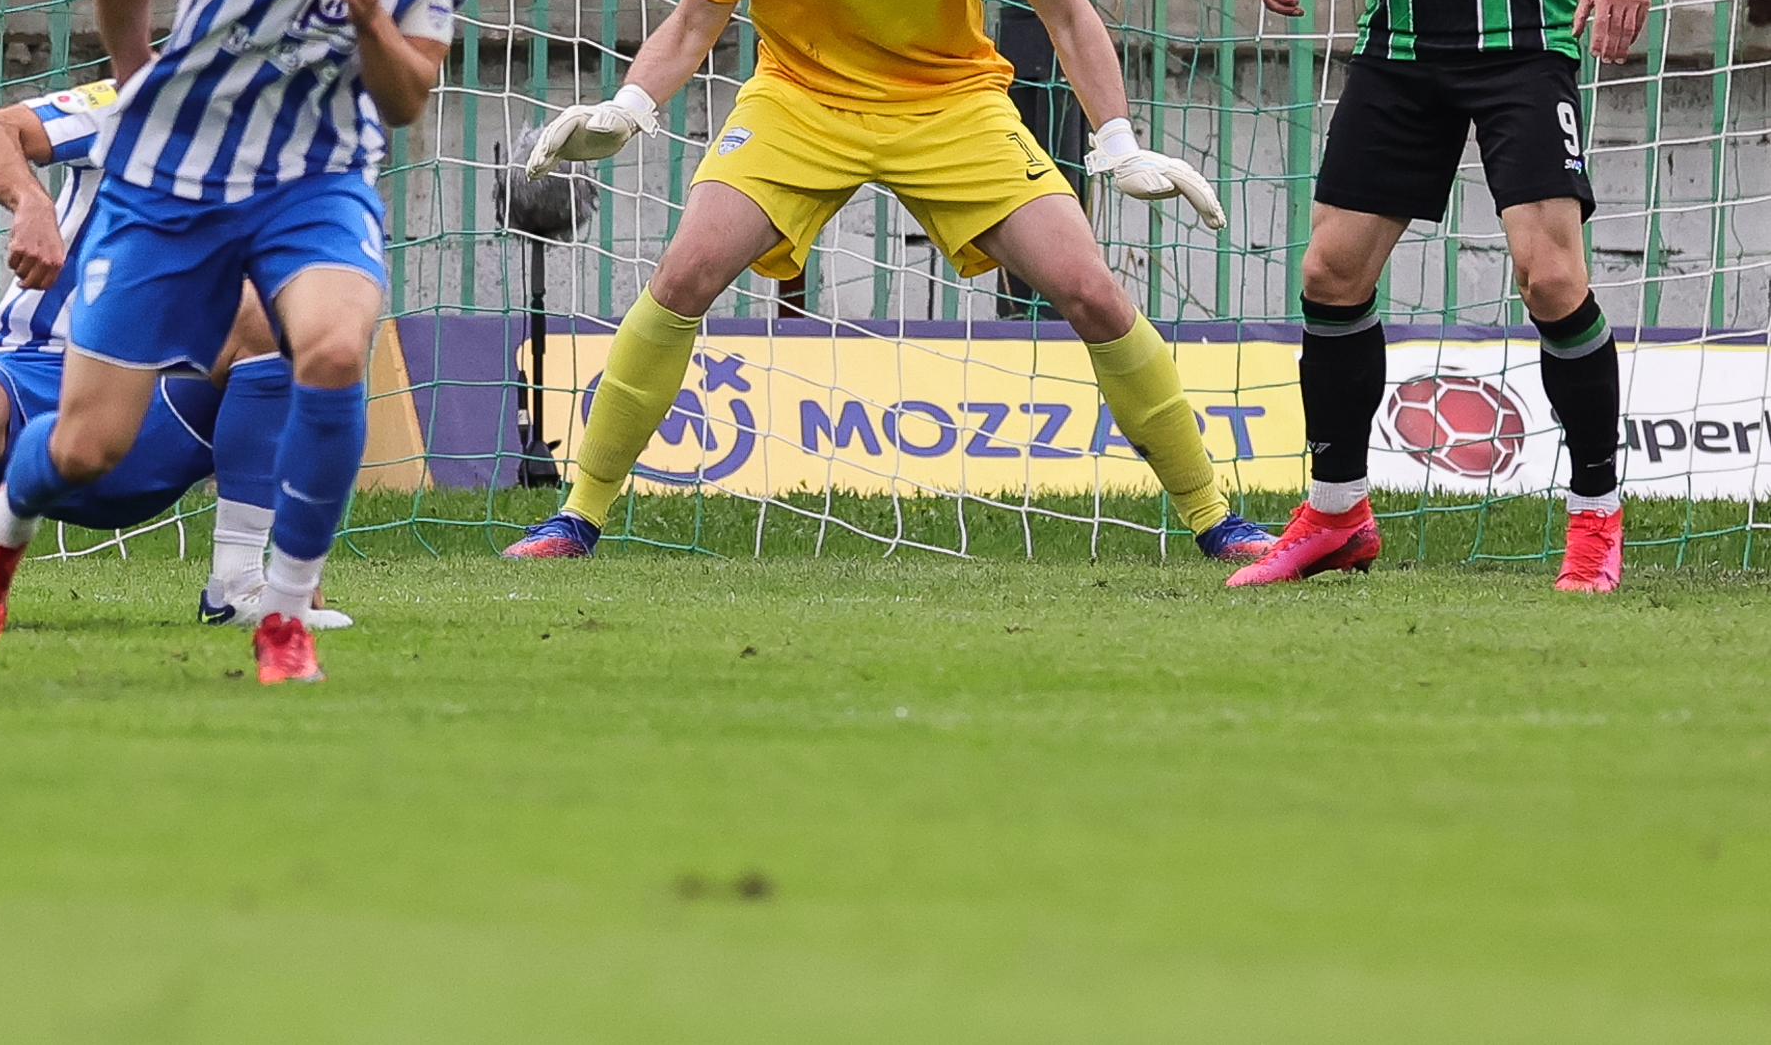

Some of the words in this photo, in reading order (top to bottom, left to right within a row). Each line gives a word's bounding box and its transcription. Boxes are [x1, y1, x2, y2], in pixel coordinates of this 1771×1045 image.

[1005, 131, 1046, 168] 1
[1556, 101, 1580, 157] 9
[799, 399, 1267, 462] MOZZAT
[1550, 407, 1771, 464] uper
